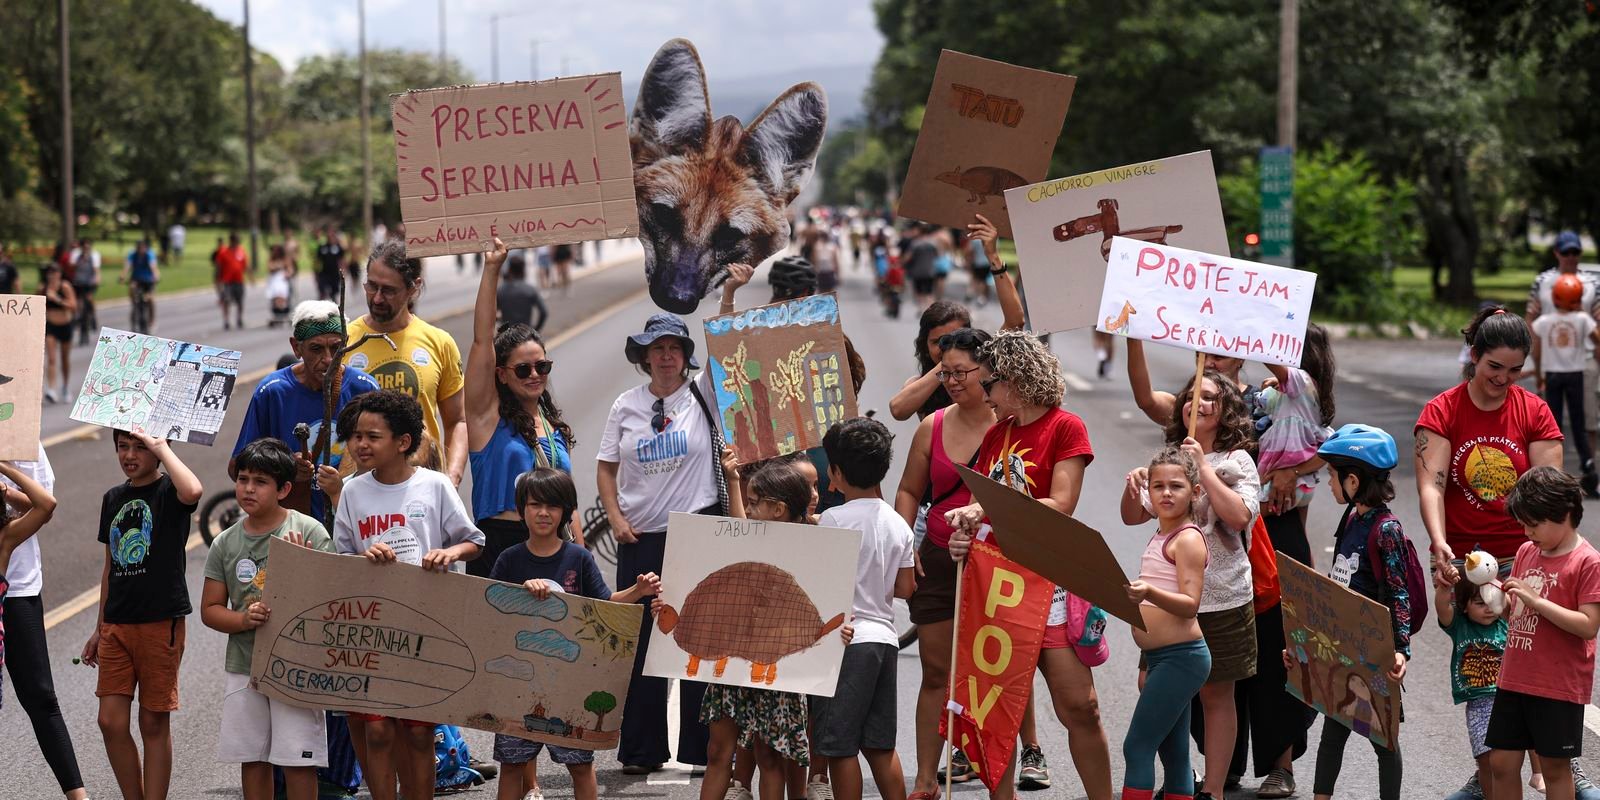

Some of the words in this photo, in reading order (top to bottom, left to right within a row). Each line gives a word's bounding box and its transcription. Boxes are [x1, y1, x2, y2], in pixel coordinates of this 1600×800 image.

[951, 82, 1025, 129] TATU
[431, 99, 584, 148] PRESERVA
[421, 160, 579, 202] SERRINHA
[1027, 175, 1094, 203] CACHORRO
[1104, 164, 1157, 184] VINAGRE
[435, 223, 479, 243] ÁGUA
[489, 217, 499, 237] É
[1199, 297, 1214, 315] A
[637, 429, 688, 463] CERRADO
[1453, 440, 1477, 467] PRECISA
[1477, 436, 1488, 444] DA
[643, 457, 685, 470] CORAÇÃO
[644, 467, 658, 476] DAS
[714, 520, 769, 538] JABUTI
[322, 600, 382, 622] SALVE
[289, 616, 306, 638] A
[322, 620, 424, 658] SERRINHA!
[271, 659, 285, 680] O
[324, 648, 381, 670] SALVE
